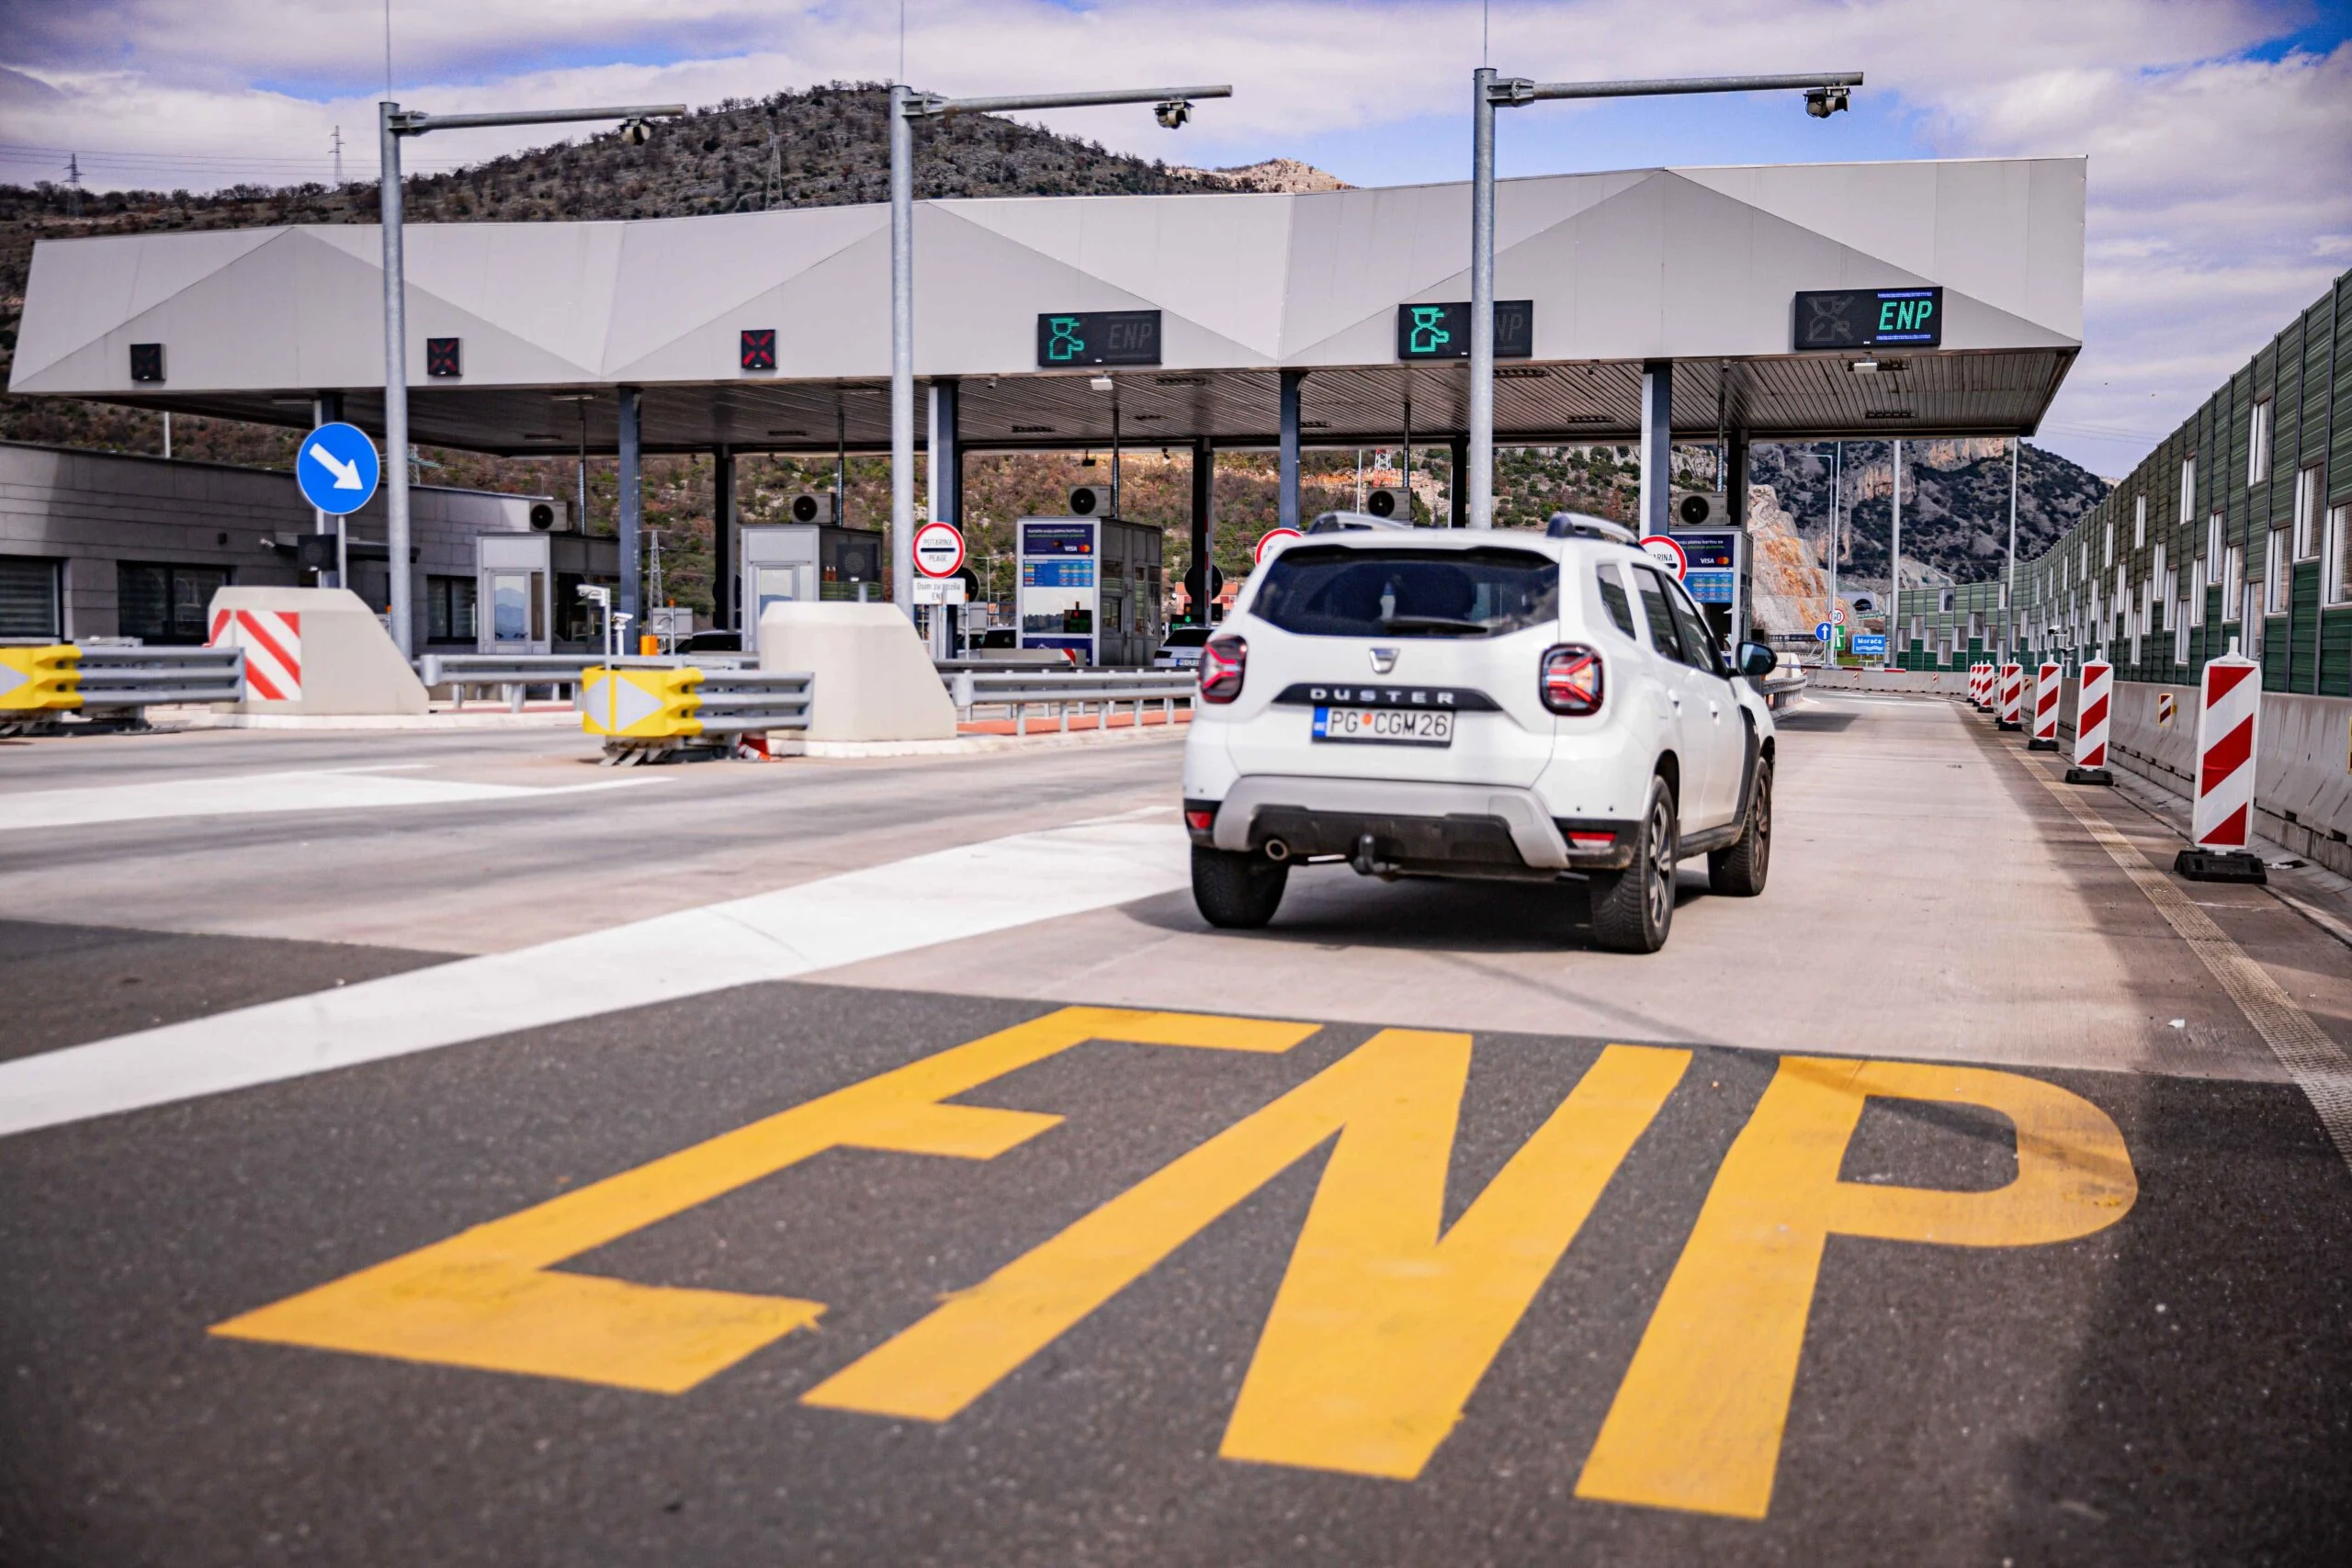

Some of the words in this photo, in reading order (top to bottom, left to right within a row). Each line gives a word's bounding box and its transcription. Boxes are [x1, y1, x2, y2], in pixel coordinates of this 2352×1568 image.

[1494, 313, 1524, 342] NP
[1878, 300, 1933, 330] ENP
[1108, 323, 1153, 349] ENP
[943, 582, 960, 591] ozila
[1310, 688, 1454, 705] DUSTER
[1331, 711, 1358, 733] PG
[210, 1006, 2137, 1520] ENP
